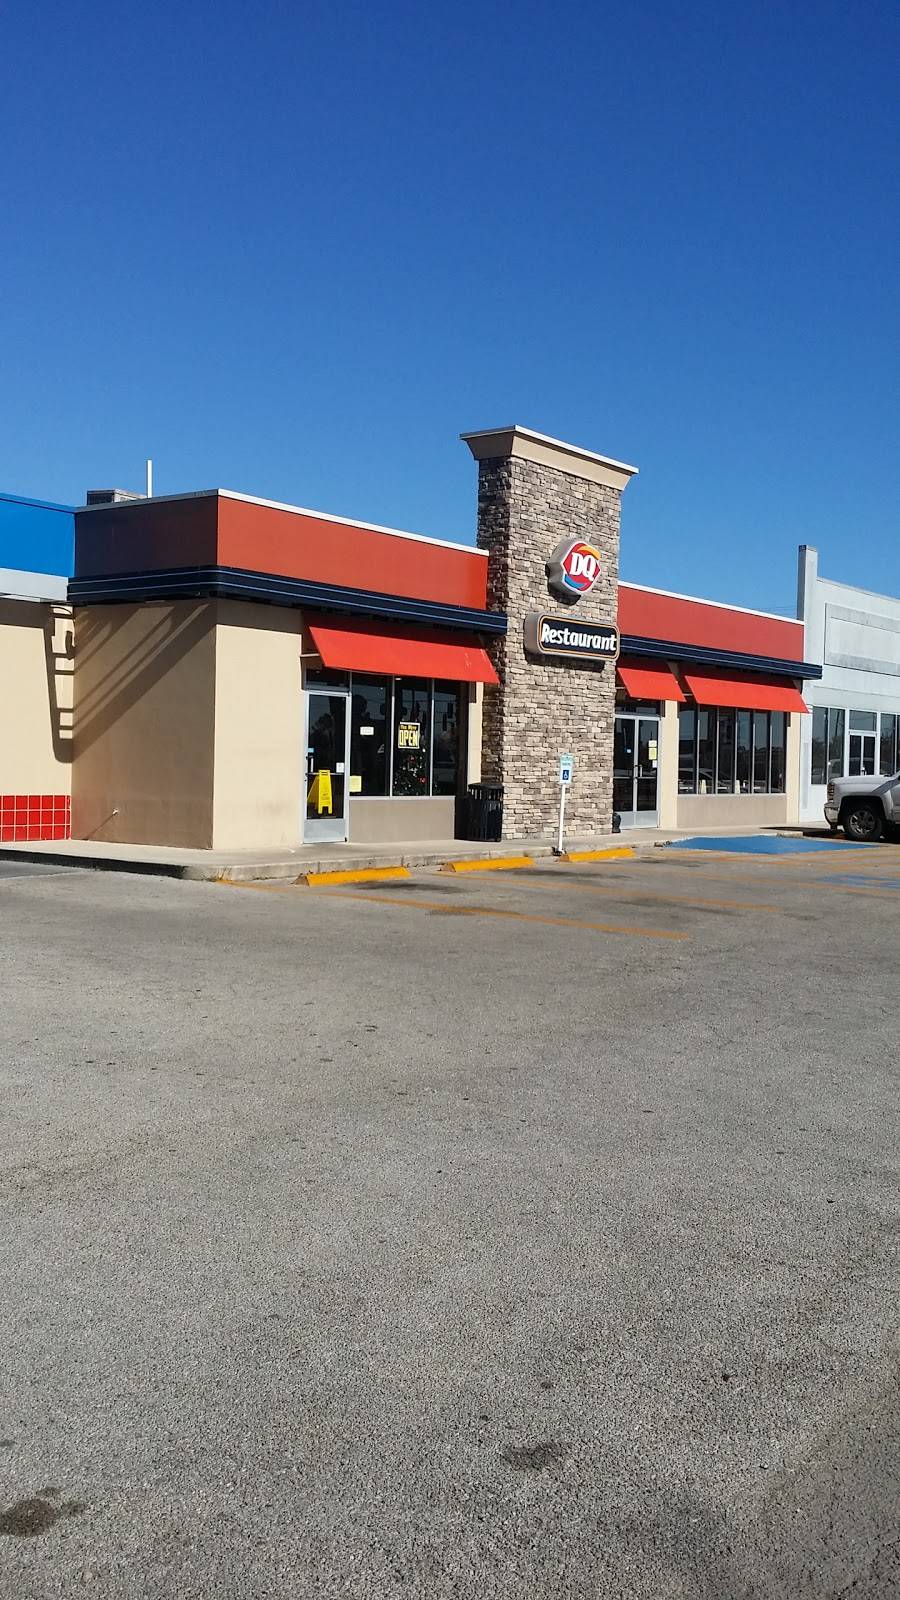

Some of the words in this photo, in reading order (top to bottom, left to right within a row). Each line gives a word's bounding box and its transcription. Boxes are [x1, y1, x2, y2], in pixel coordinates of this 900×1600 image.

[570, 552, 596, 581] DQ
[541, 623, 617, 651] Restaurant
[399, 730, 418, 747] OPEN
